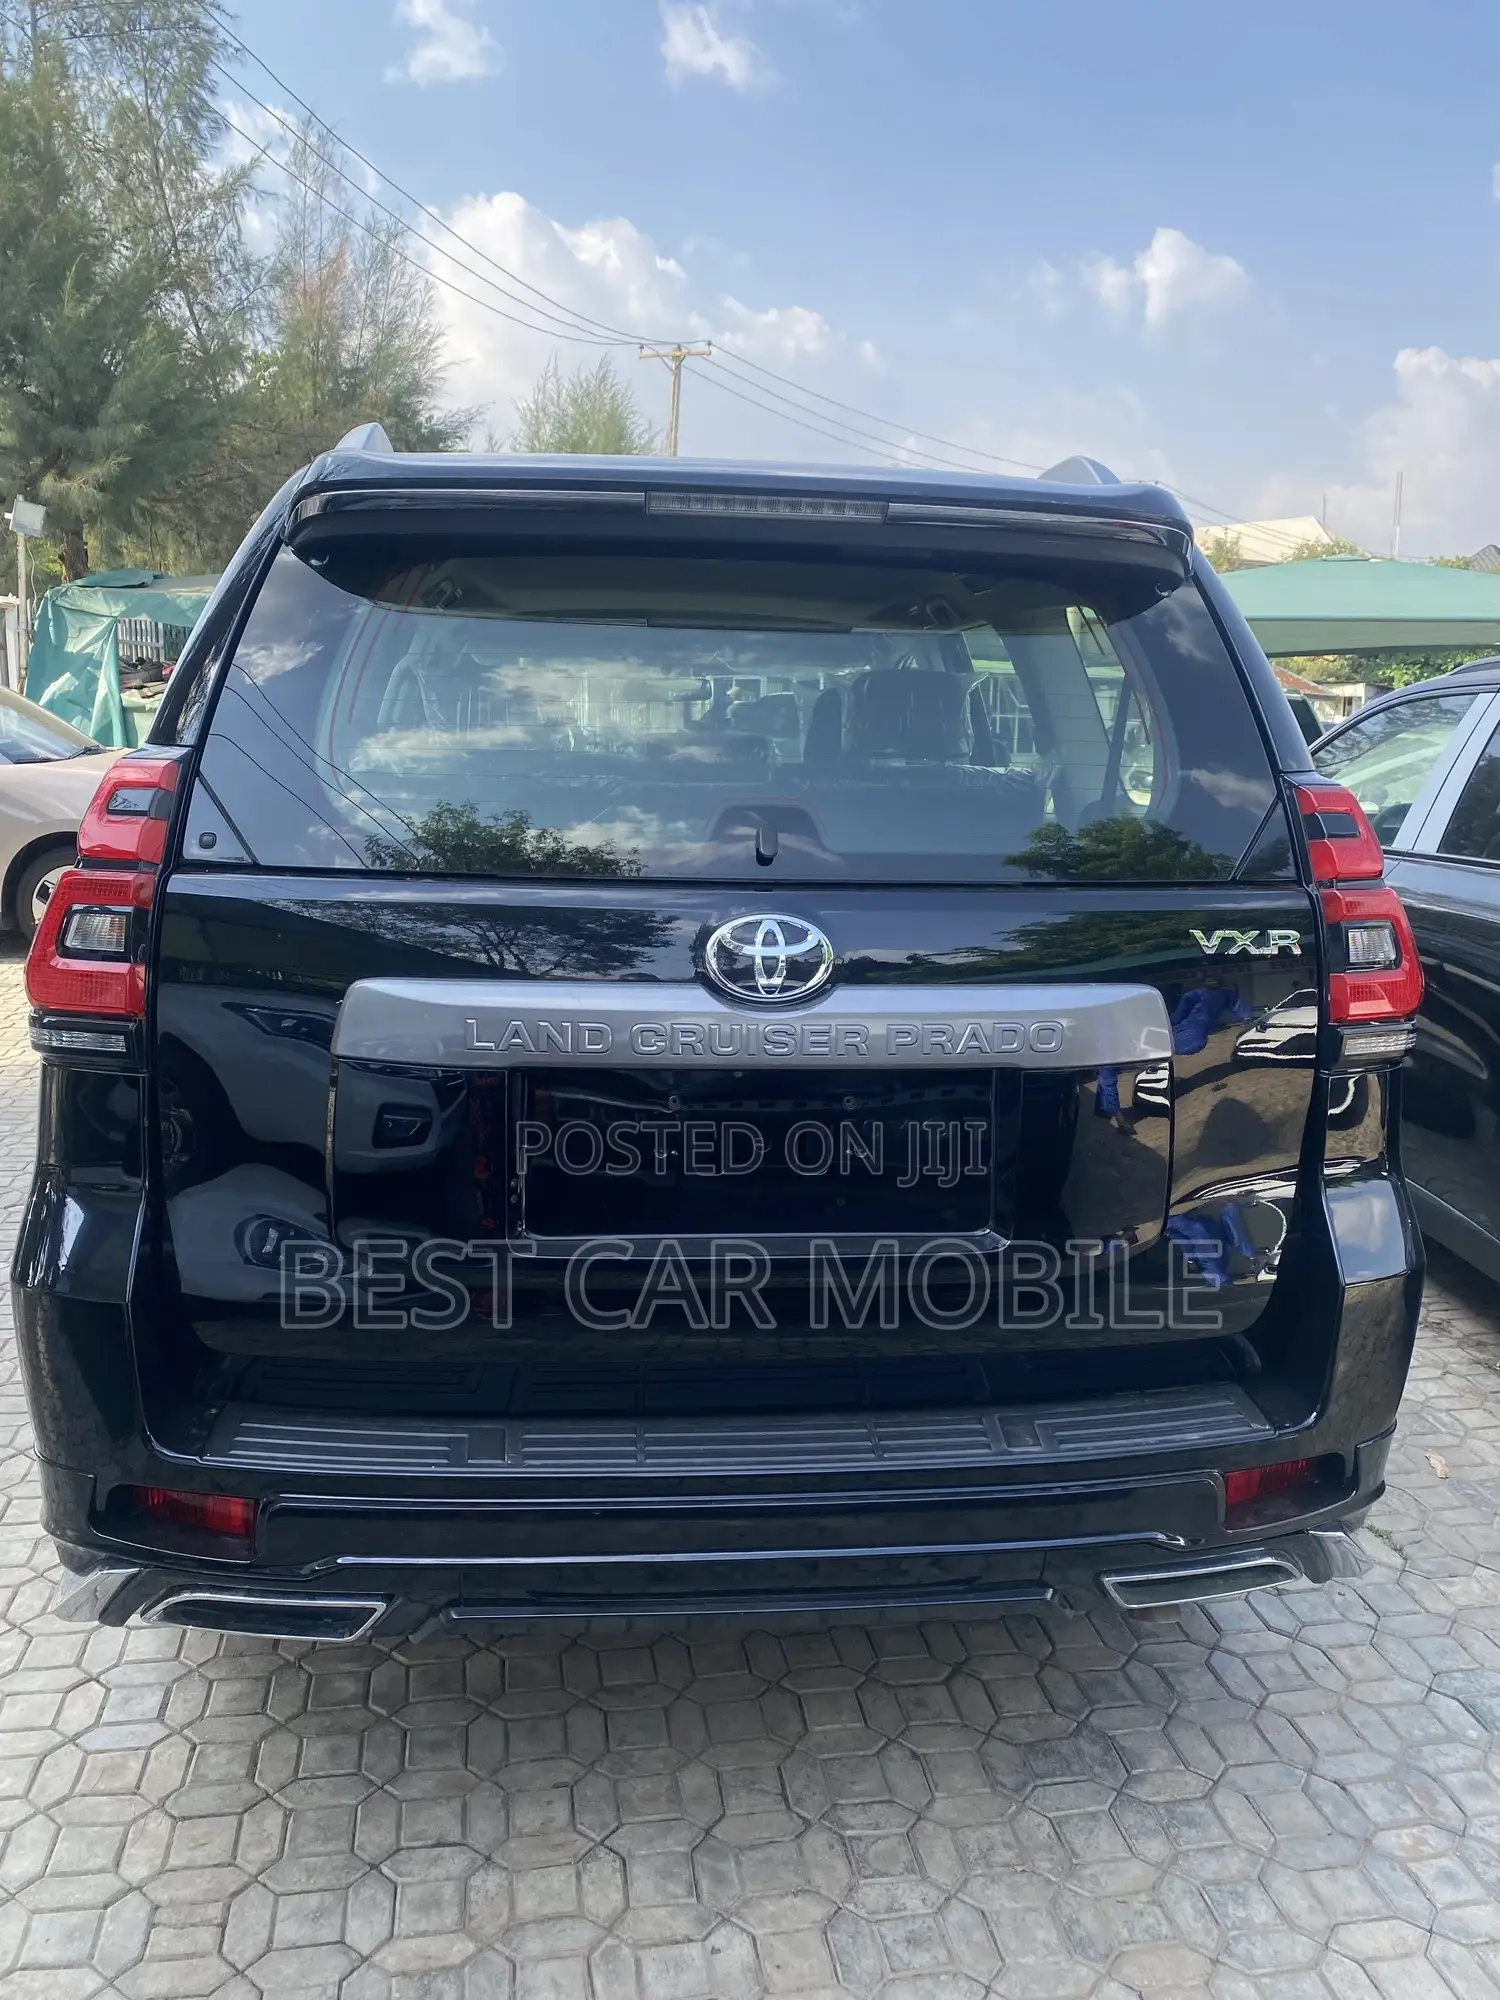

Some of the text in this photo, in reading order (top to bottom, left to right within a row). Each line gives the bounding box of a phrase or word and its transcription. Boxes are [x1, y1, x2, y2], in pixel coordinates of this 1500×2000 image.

[465, 1018, 1065, 1058] LAND CRUISER PRADO
